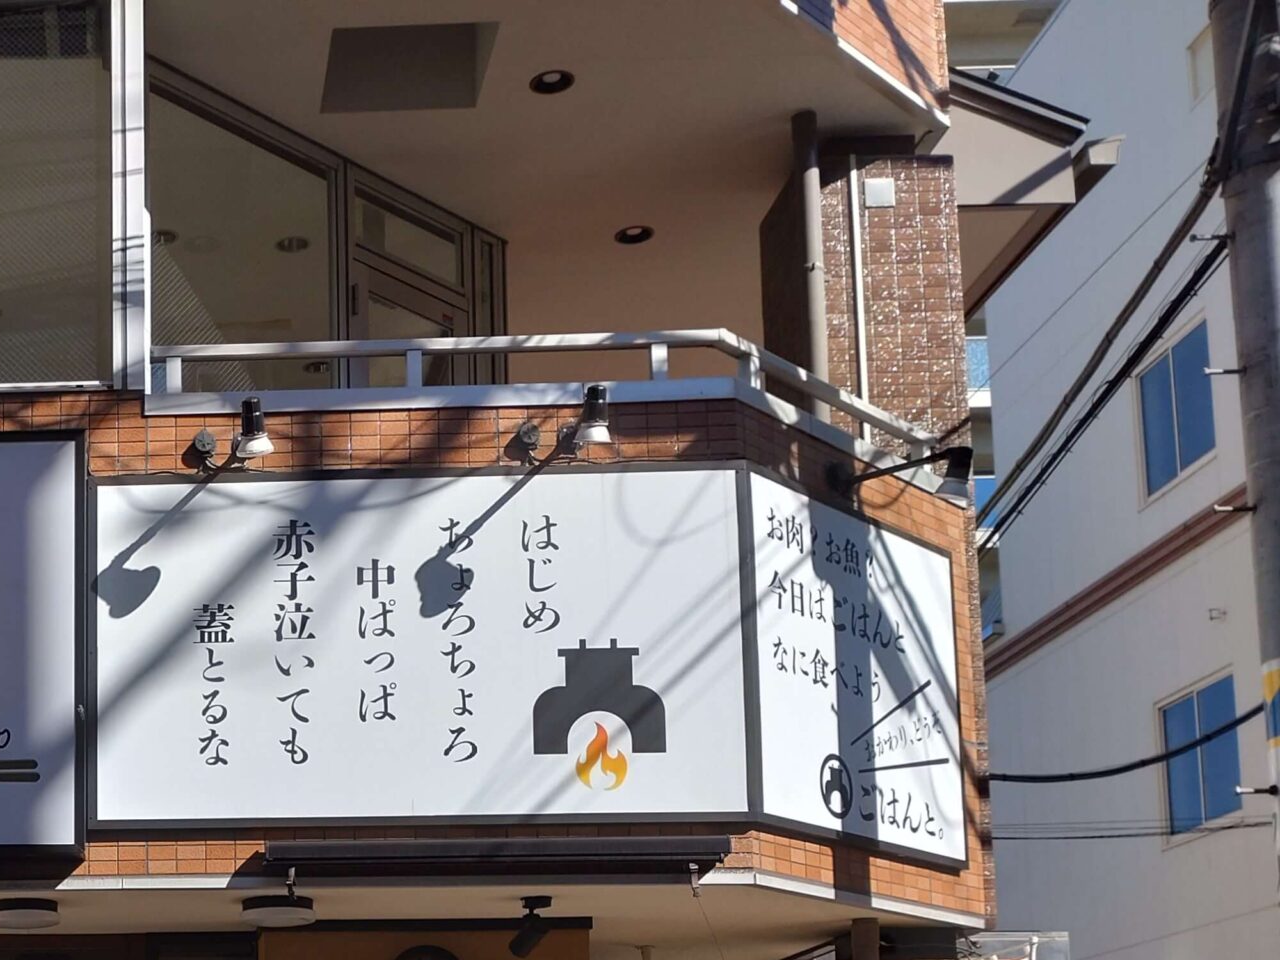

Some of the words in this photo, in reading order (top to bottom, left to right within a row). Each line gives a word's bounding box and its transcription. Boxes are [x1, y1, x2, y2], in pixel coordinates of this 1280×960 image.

[520, 513, 561, 634] はじめ
[767, 570, 906, 654] 今日はごはんと
[192, 603, 236, 767] 蓋とるな
[272, 519, 317, 766] 赤子泣いても
[355, 558, 398, 723] 中ぱっぱ
[438, 517, 478, 763] ちょろちょろ
[773, 636, 881, 703] なに食べよう
[864, 711, 942, 763] おかわり、どうぞ
[859, 785, 945, 841] ごはんと。
